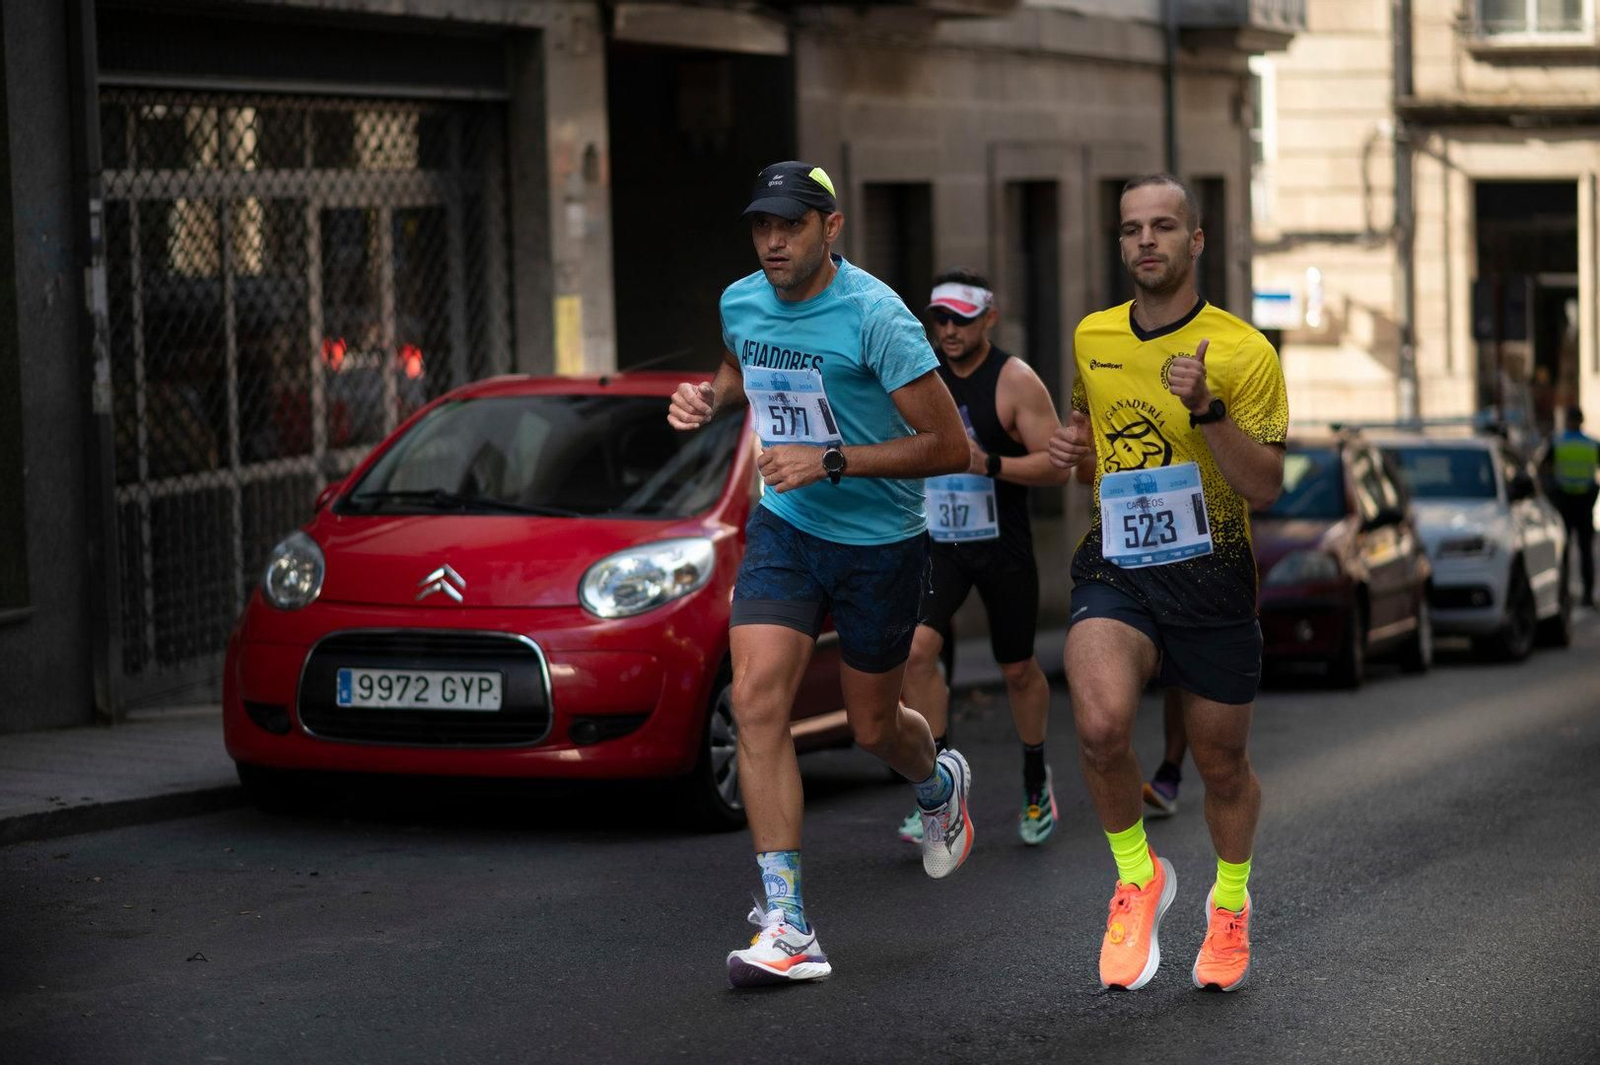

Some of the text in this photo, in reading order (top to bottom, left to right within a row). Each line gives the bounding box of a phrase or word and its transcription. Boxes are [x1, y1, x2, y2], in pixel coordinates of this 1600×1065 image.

[741, 339, 823, 375] AFIADORES
[768, 405, 810, 436] 577
[1105, 398, 1166, 429] GANADERÍA
[938, 503, 970, 527] 317
[1123, 509, 1178, 549] 523
[358, 673, 494, 704] 9972 GYP
